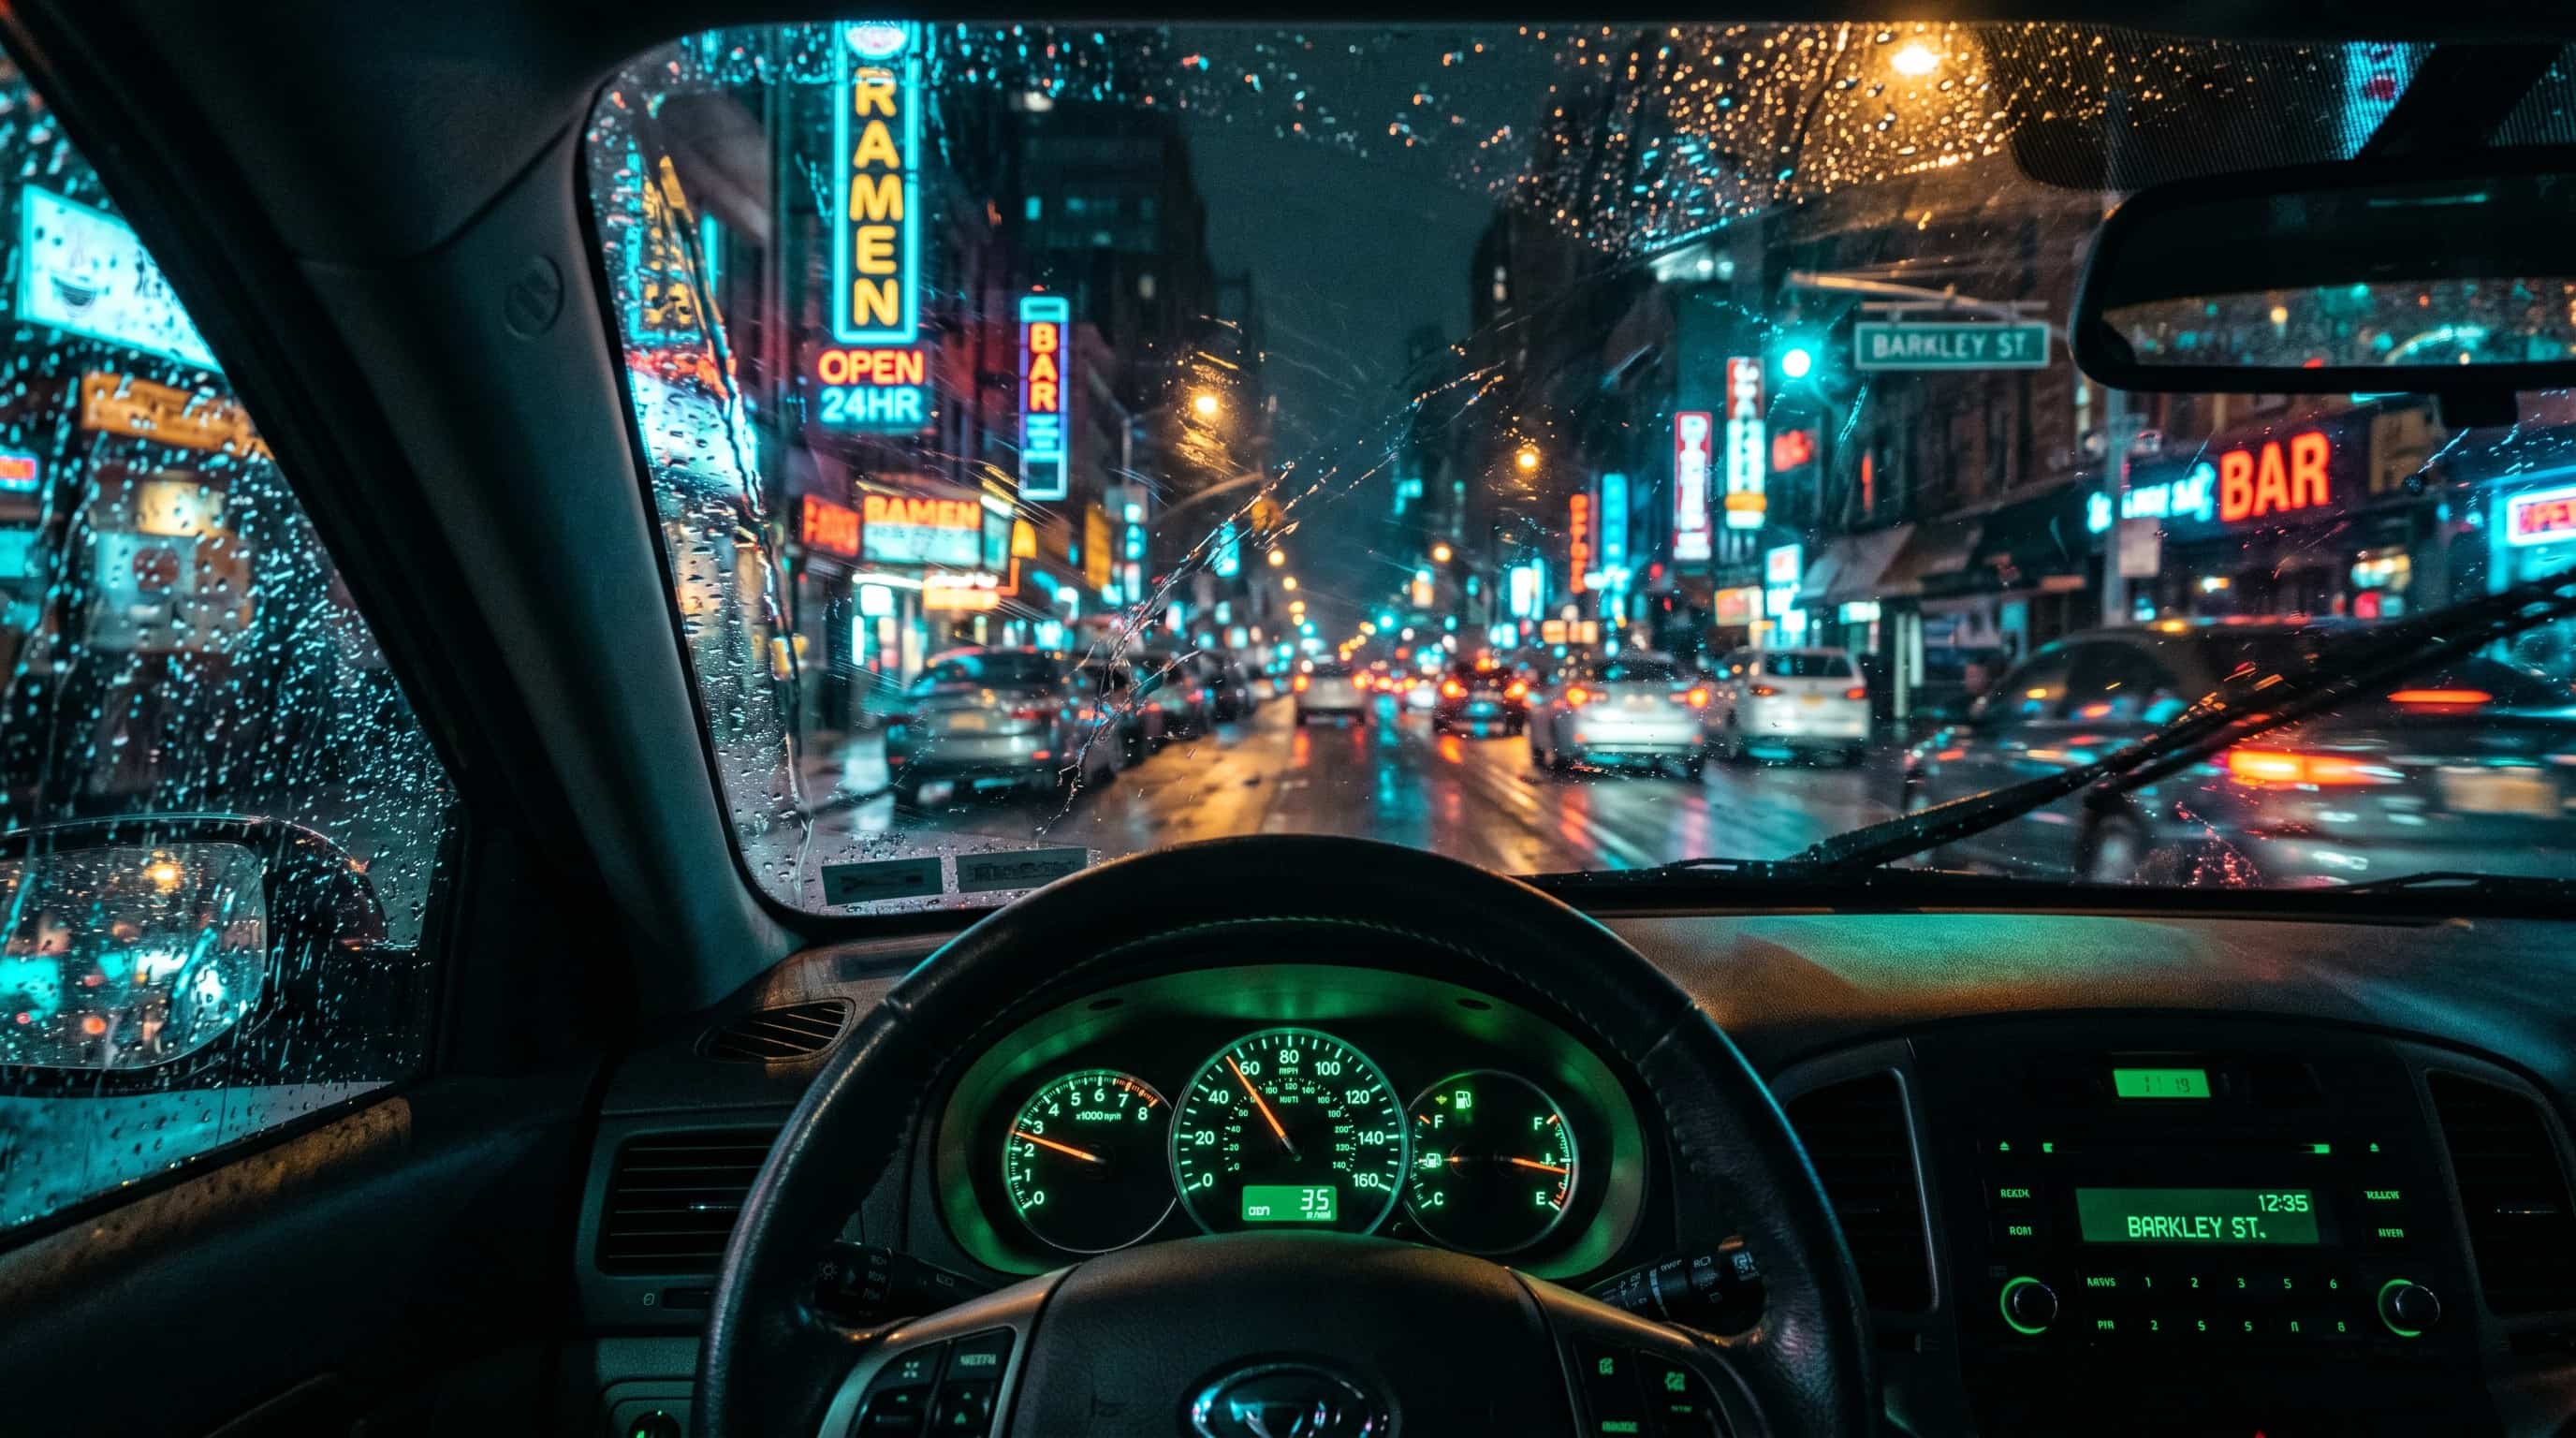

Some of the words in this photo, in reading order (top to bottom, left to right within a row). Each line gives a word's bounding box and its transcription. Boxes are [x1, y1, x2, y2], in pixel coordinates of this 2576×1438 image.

[849, 66, 905, 327] RAMEN
[1873, 332, 1985, 359] BARKLEY
[1997, 331, 2027, 359] ST
[816, 348, 926, 386] OPEN
[1029, 322, 1059, 412] BAR
[820, 387, 923, 425] 24HR
[2219, 430, 2332, 523] BAR
[1279, 1049, 1300, 1064] 80
[1239, 1061, 1261, 1077] 60
[1314, 1061, 1341, 1077] 100
[1070, 1092, 1082, 1107] 5
[1094, 1088, 1106, 1103] 6
[1118, 1093, 1130, 1108] 7
[1208, 1089, 1230, 1106] 40
[1344, 1089, 1371, 1106] 120
[1047, 1102, 1061, 1117] 4
[1137, 1106, 1149, 1122] 8
[1032, 1119, 1045, 1135] 3
[1433, 1113, 1445, 1129] F
[1532, 1116, 1544, 1131] F
[1194, 1129, 1216, 1146] 20
[1357, 1129, 1385, 1146] 140
[1023, 1142, 1035, 1158] 2
[1023, 1167, 1032, 1182] 1
[1202, 1172, 1215, 1189] 0
[1352, 1172, 1380, 1189] 160
[1032, 1190, 1046, 1207] 0
[1299, 1188, 1330, 1211] 35
[1433, 1191, 1445, 1207] C
[1535, 1191, 1547, 1207] E
[2258, 1194, 2310, 1212] 12:35
[2127, 1215, 2223, 1240] BARKLEY
[2232, 1216, 2267, 1240] ST.
[2144, 1276, 2152, 1289] 1
[2189, 1277, 2200, 1289] 2
[2236, 1277, 2247, 1289] 3
[2282, 1278, 2292, 1290] 5
[2329, 1278, 2338, 1290] 6
[2150, 1319, 2159, 1331] 2
